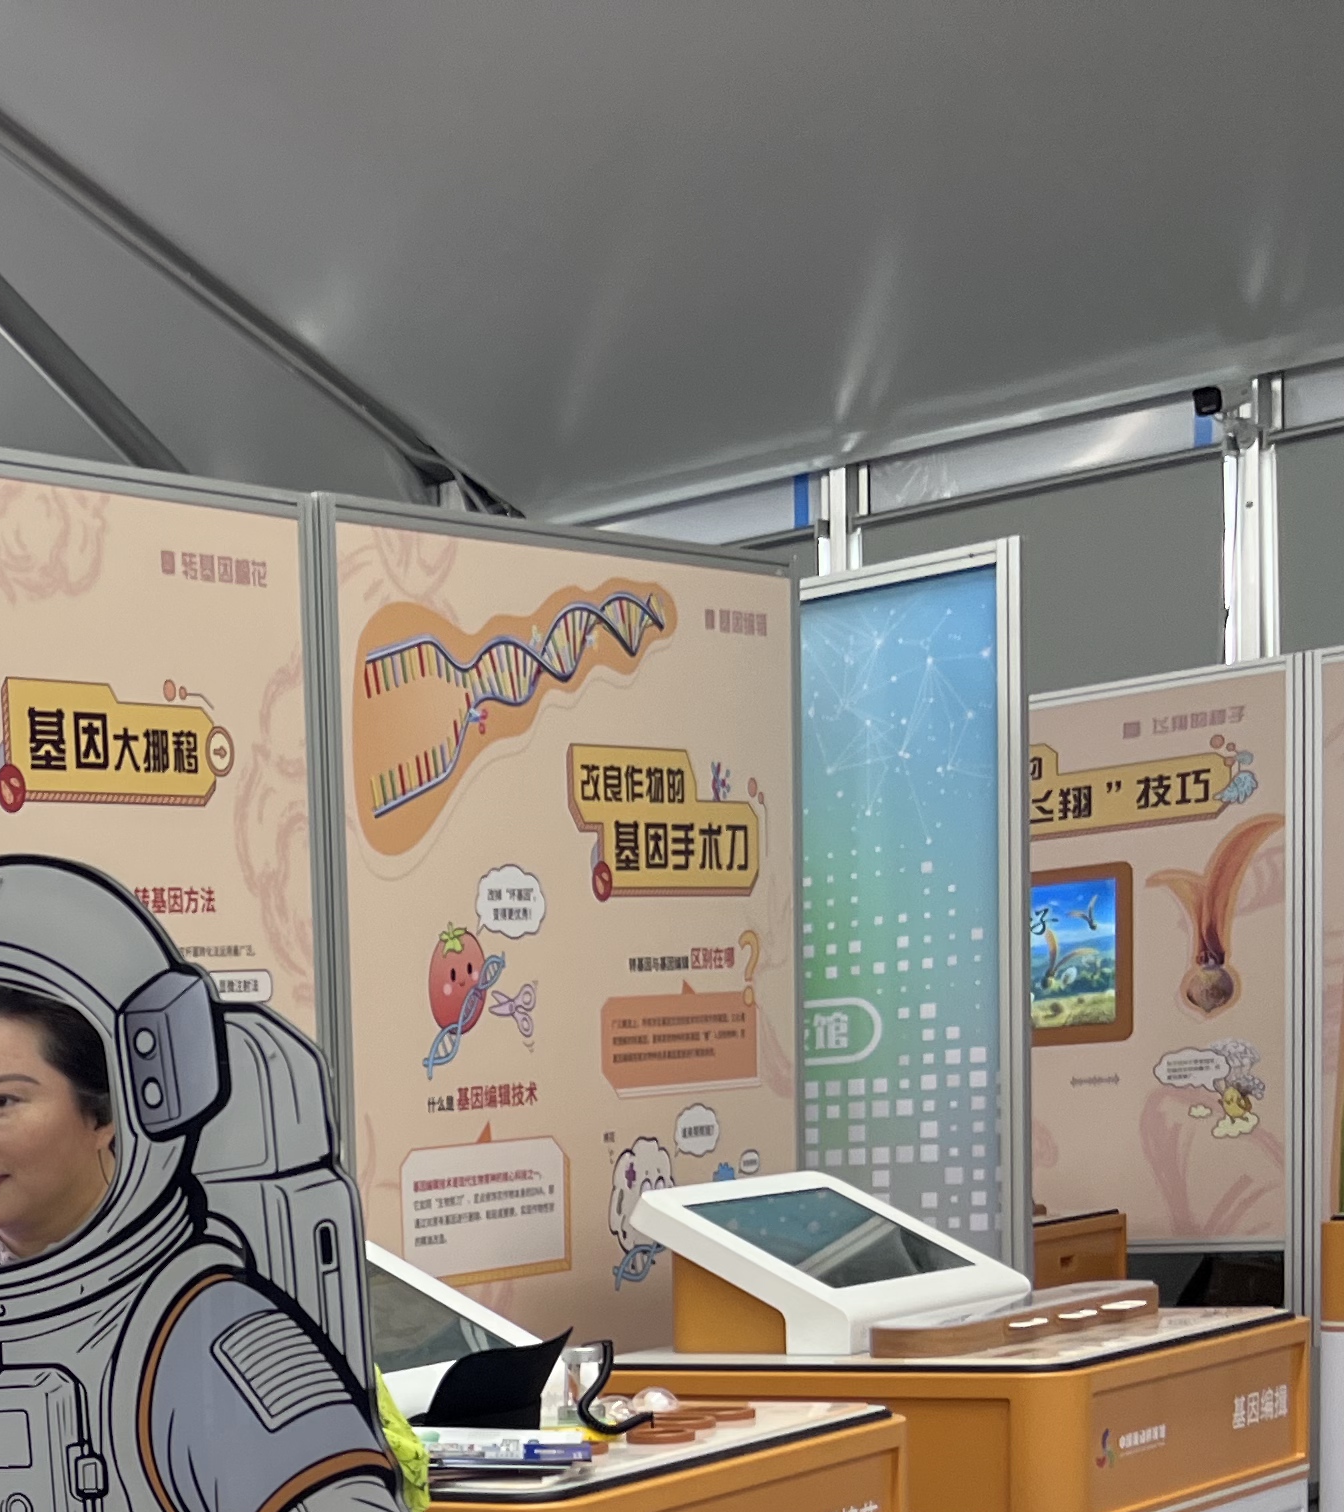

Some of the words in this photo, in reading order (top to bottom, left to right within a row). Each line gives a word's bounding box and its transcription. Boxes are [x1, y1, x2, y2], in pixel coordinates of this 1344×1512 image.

[27, 706, 200, 775] 基因大挪移
[580, 763, 685, 804] 改良作物的
[614, 820, 749, 872] 基因手术刀
[427, 1081, 538, 1114] 什么是基因编辑技术
